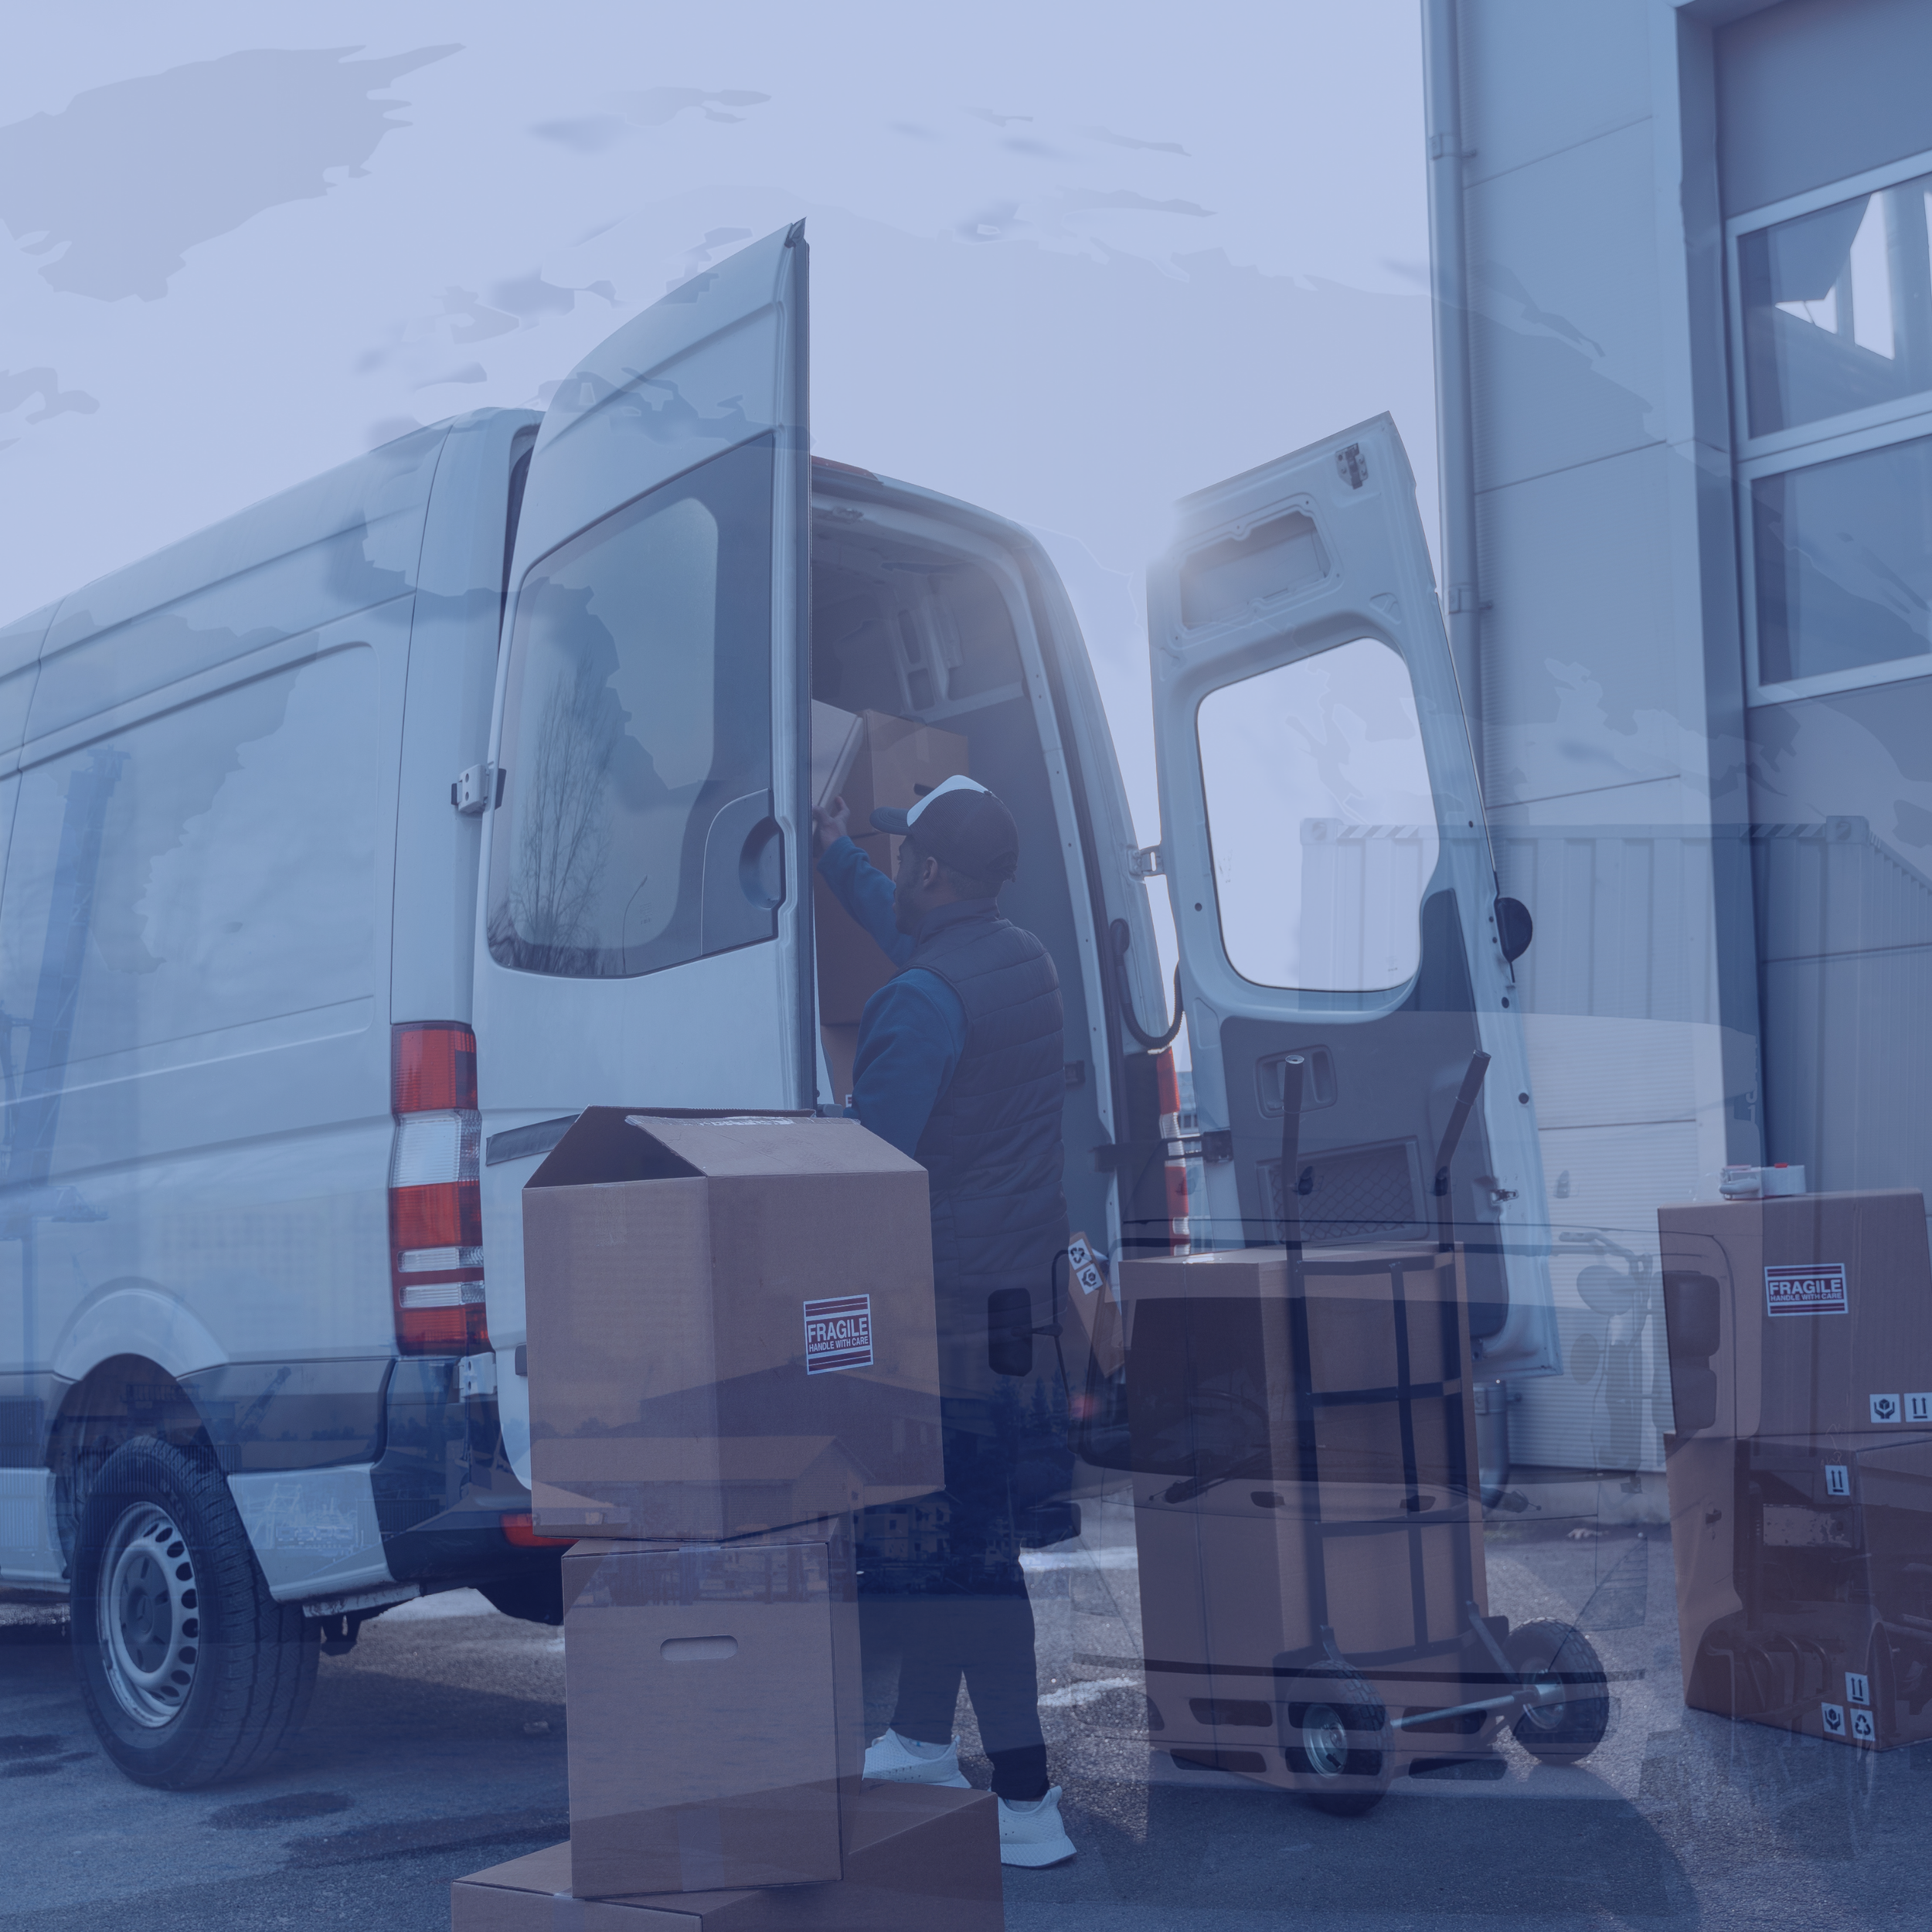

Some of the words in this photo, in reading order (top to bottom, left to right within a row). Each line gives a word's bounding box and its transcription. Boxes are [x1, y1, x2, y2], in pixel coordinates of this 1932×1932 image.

[1770, 1279, 1842, 1295] FRAGILE
[808, 1317, 868, 1343] FRAGILE
[809, 1341, 835, 1352] HANDLE
[835, 1338, 851, 1349] WITH
[852, 1335, 869, 1346] CARE
